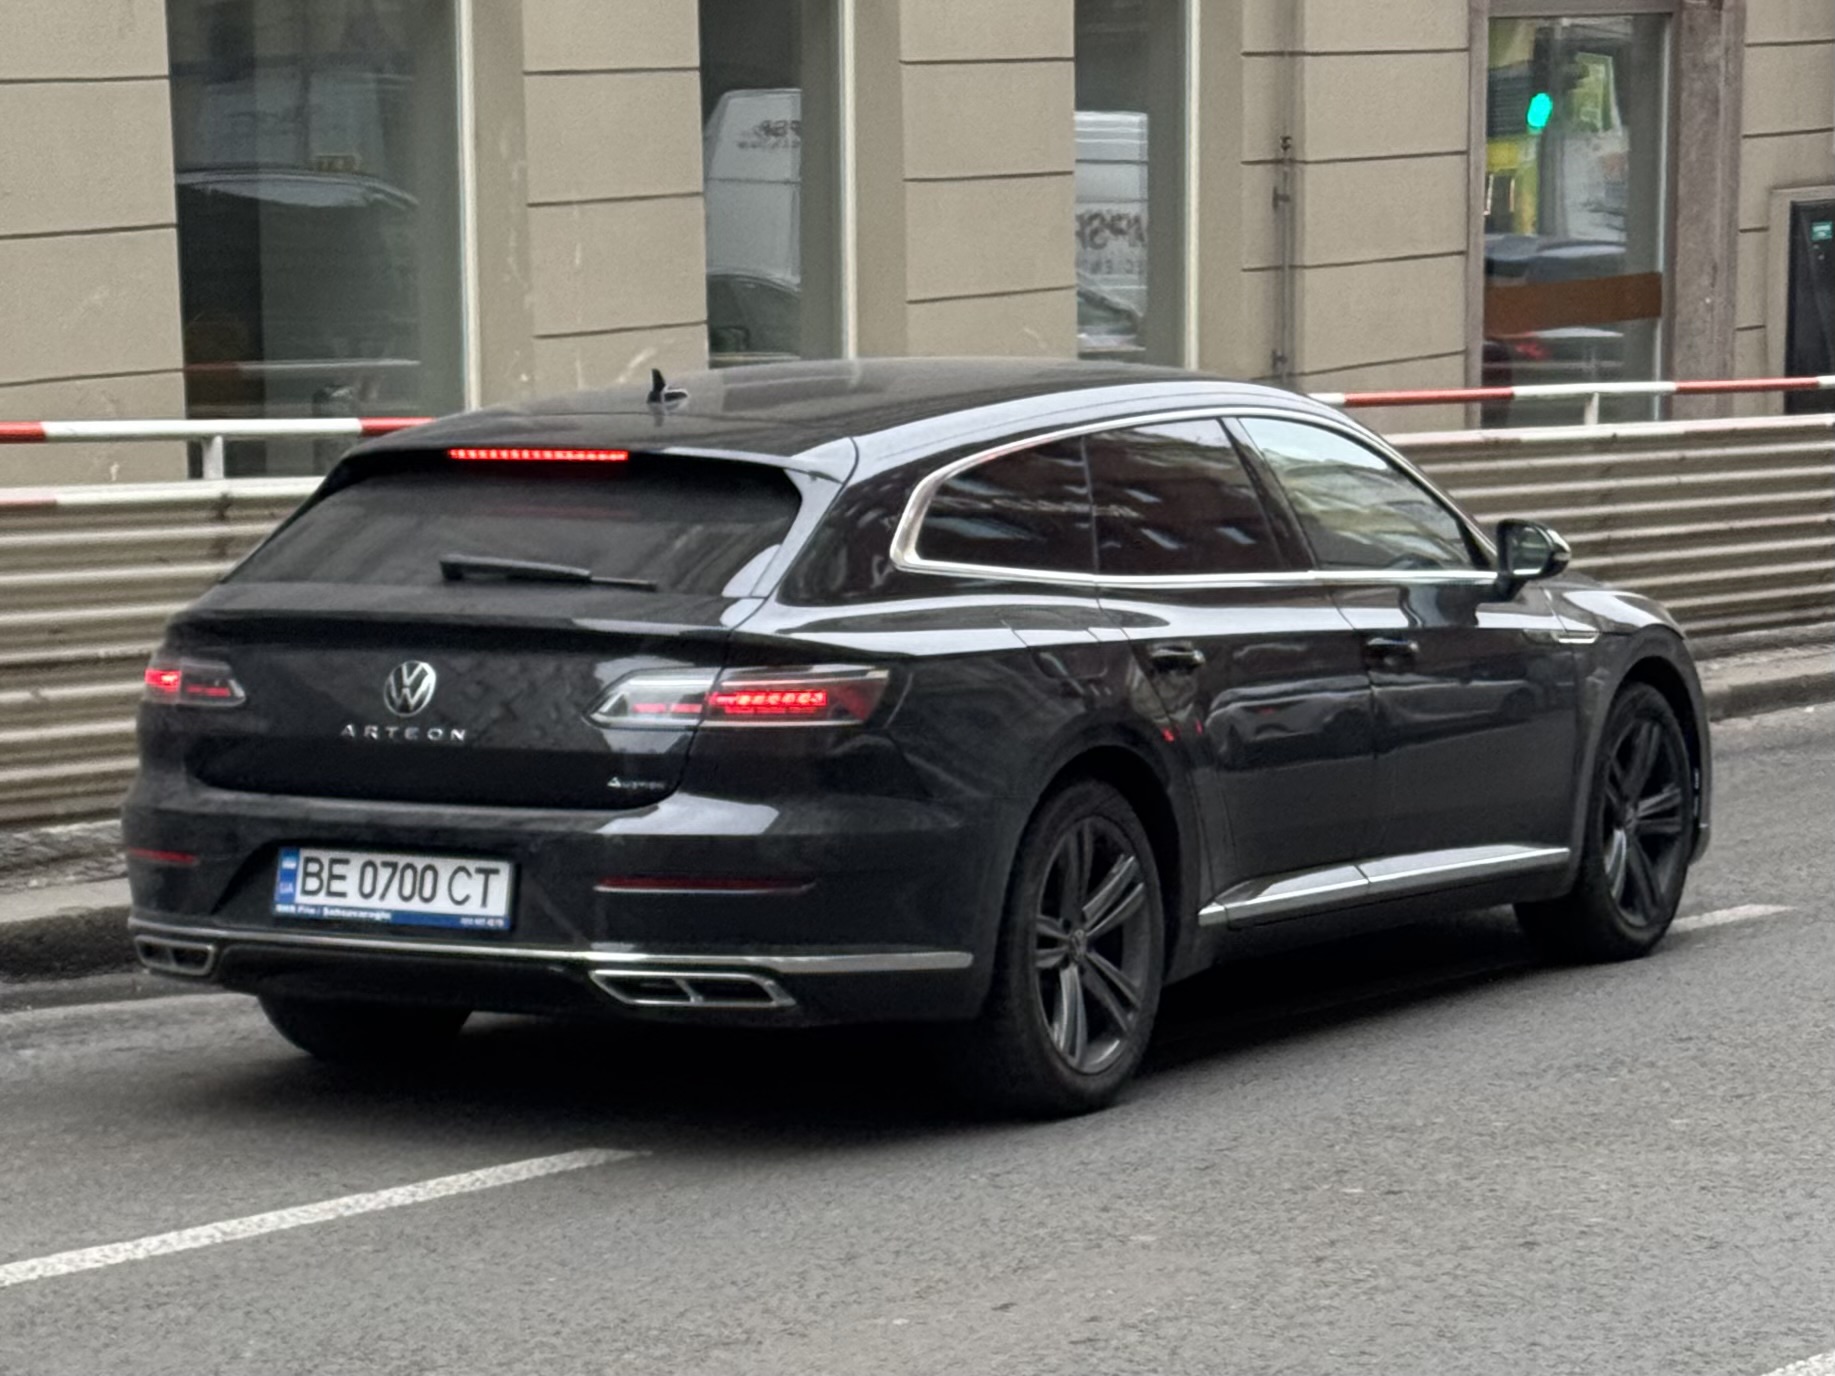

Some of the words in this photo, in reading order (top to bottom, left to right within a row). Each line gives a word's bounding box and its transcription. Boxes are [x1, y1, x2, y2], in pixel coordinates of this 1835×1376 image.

[384, 660, 437, 717] VW
[340, 724, 468, 742] ARTEON
[300, 856, 350, 898] BE
[358, 859, 439, 903] 0700
[448, 865, 500, 908] CT
